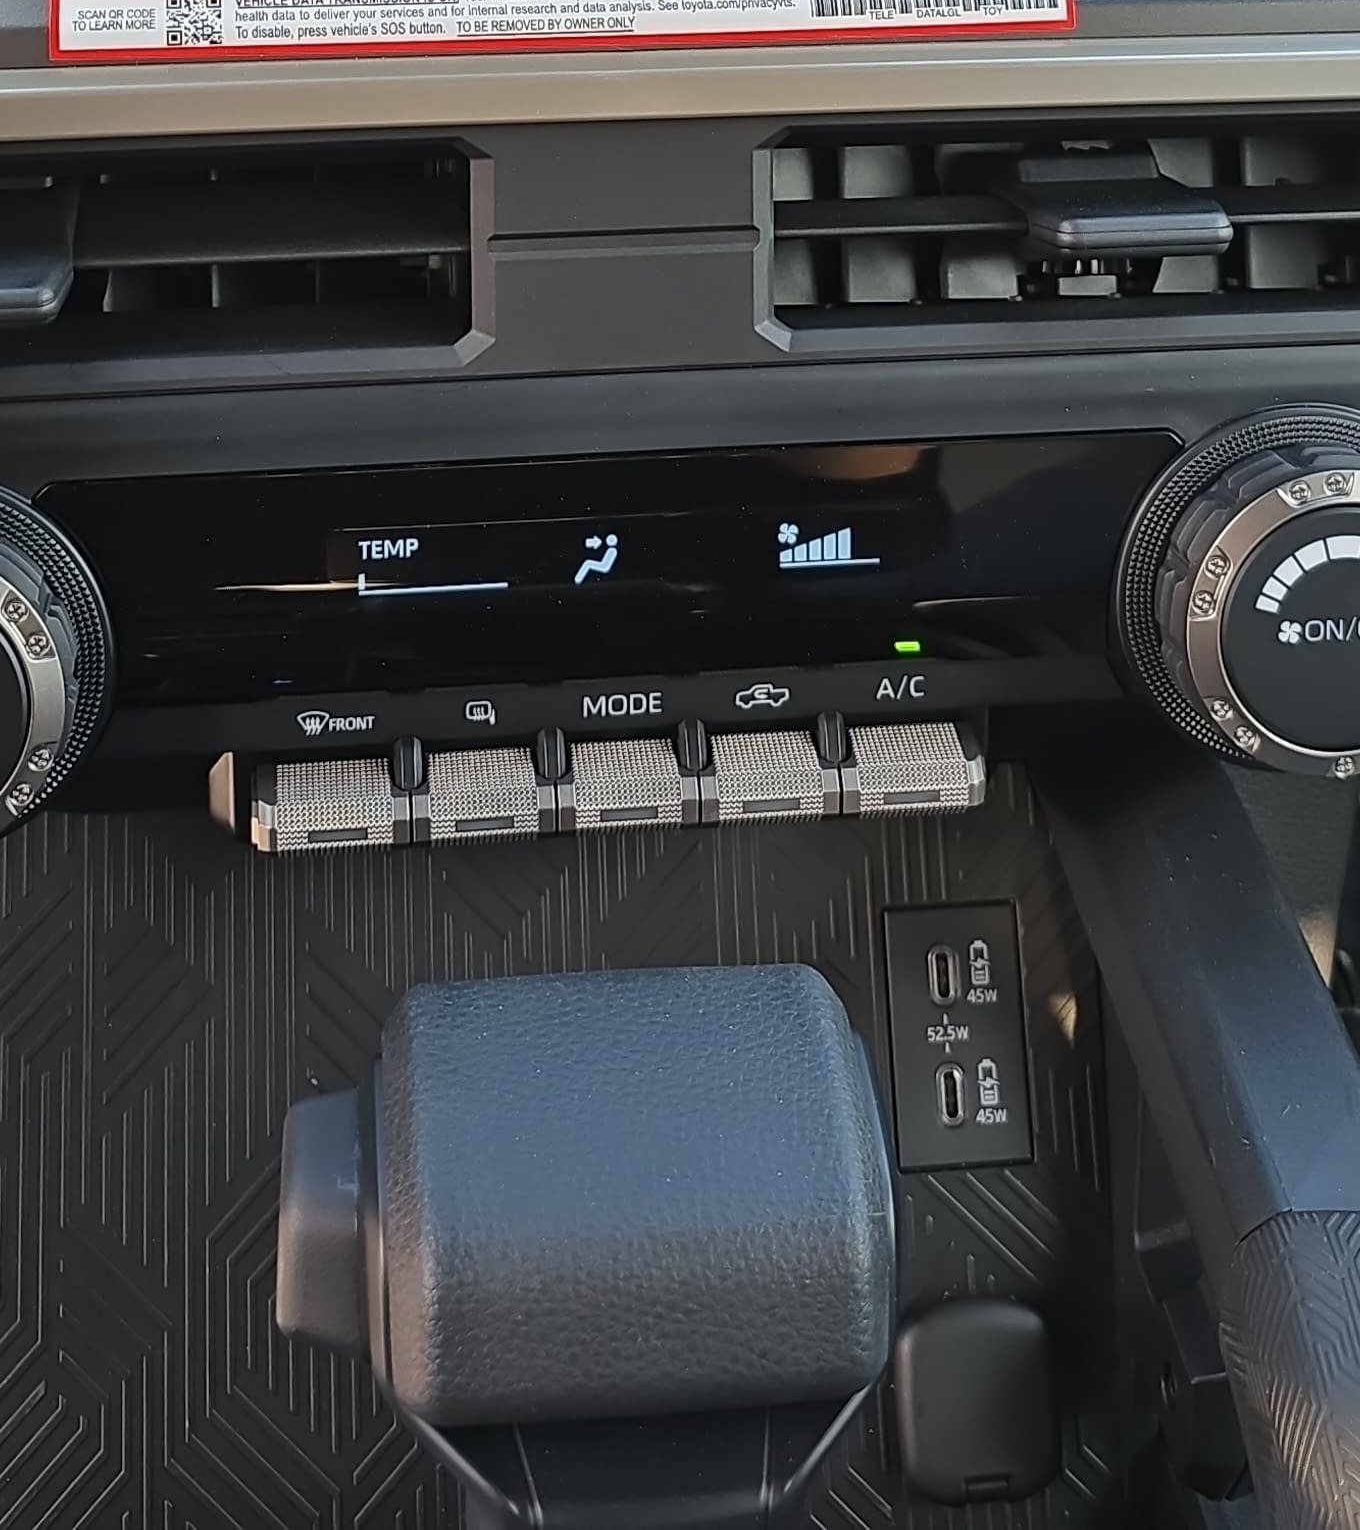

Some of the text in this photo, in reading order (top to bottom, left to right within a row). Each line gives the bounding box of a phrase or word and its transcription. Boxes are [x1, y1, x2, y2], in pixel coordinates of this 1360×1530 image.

[77, 8, 156, 20] SCAN QR CODE
[235, 9, 269, 22] health
[271, 8, 296, 21] data
[299, 9, 311, 21] to
[313, 7, 350, 21] deliver
[352, 9, 377, 23] your
[379, 7, 424, 19] services
[427, 5, 448, 17] and
[450, 4, 465, 16] for
[468, 3, 508, 16] internal
[511, 2, 557, 15] research
[559, 1, 580, 13] and
[582, 0, 606, 13] data
[609, 0, 655, 14] analysis.
[868, 10, 895, 21] TELE
[982, 5, 1004, 17] TOY
[72, 19, 156, 31] TO LEARN MORE
[235, 16, 636, 41] To disable, press vehicle's SOS button. TO BE REMOVED BY OWNER ONLY
[357, 538, 420, 561] TEMP
[875, 674, 926, 700] A/C
[581, 691, 663, 719] MODE
[327, 714, 375, 732] FRONT
[966, 988, 998, 1003] 45W
[926, 1025, 970, 1043] 52.5W
[975, 1108, 1008, 1124] 45W
